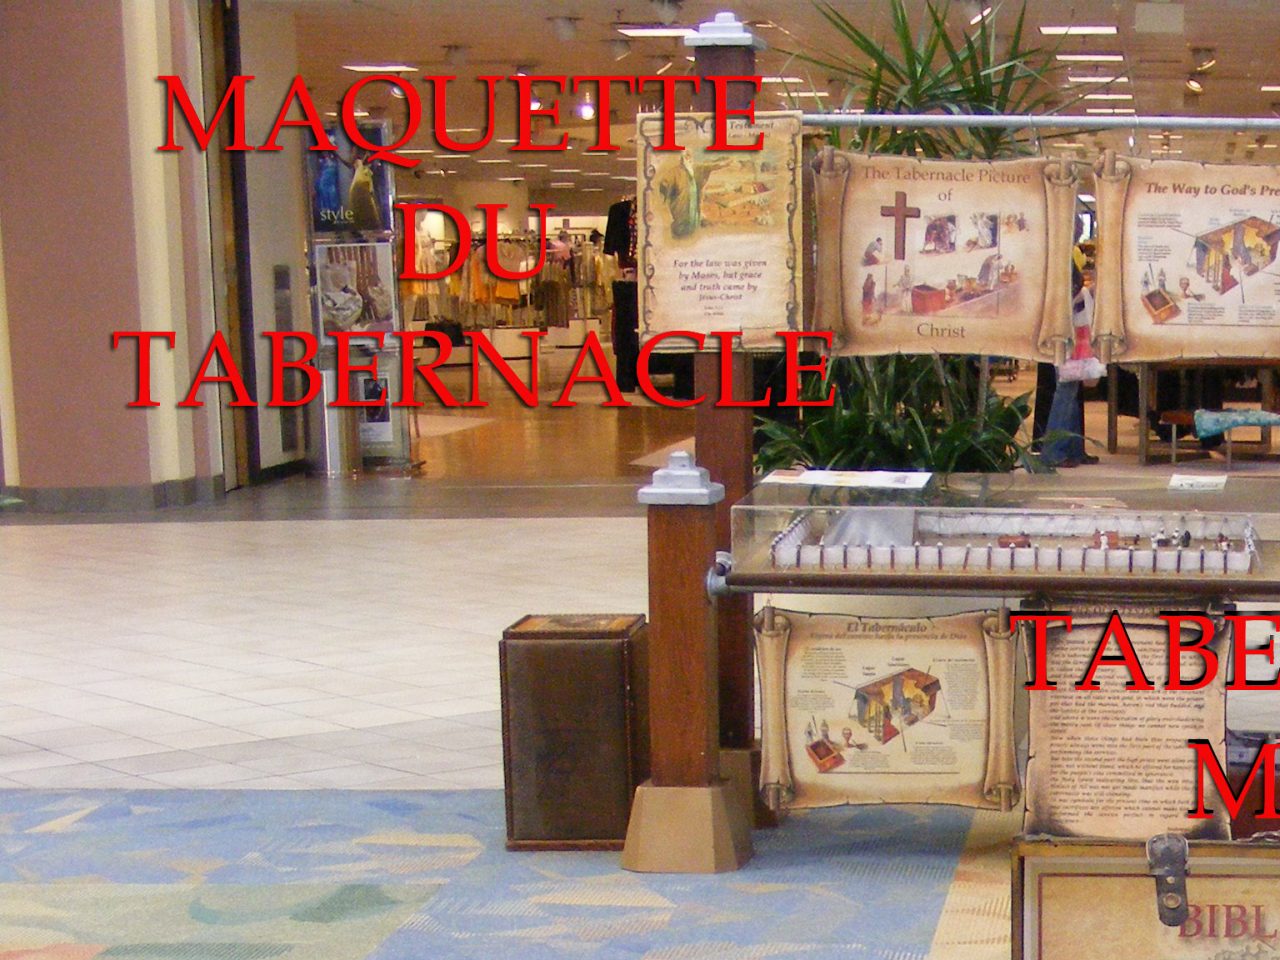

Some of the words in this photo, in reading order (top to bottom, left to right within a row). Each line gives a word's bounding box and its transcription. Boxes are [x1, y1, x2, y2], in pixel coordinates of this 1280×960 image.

[862, 166, 890, 180] The
[894, 166, 975, 182] Tabernacle
[978, 168, 1031, 184] Picture
[937, 188, 953, 201] of
[1145, 182, 1169, 195] The
[1172, 183, 1200, 198] Way
[1204, 184, 1217, 195] to
[1220, 184, 1256, 196] God's
[320, 205, 354, 224] style
[690, 259, 704, 267] the
[917, 322, 966, 338] Christ
